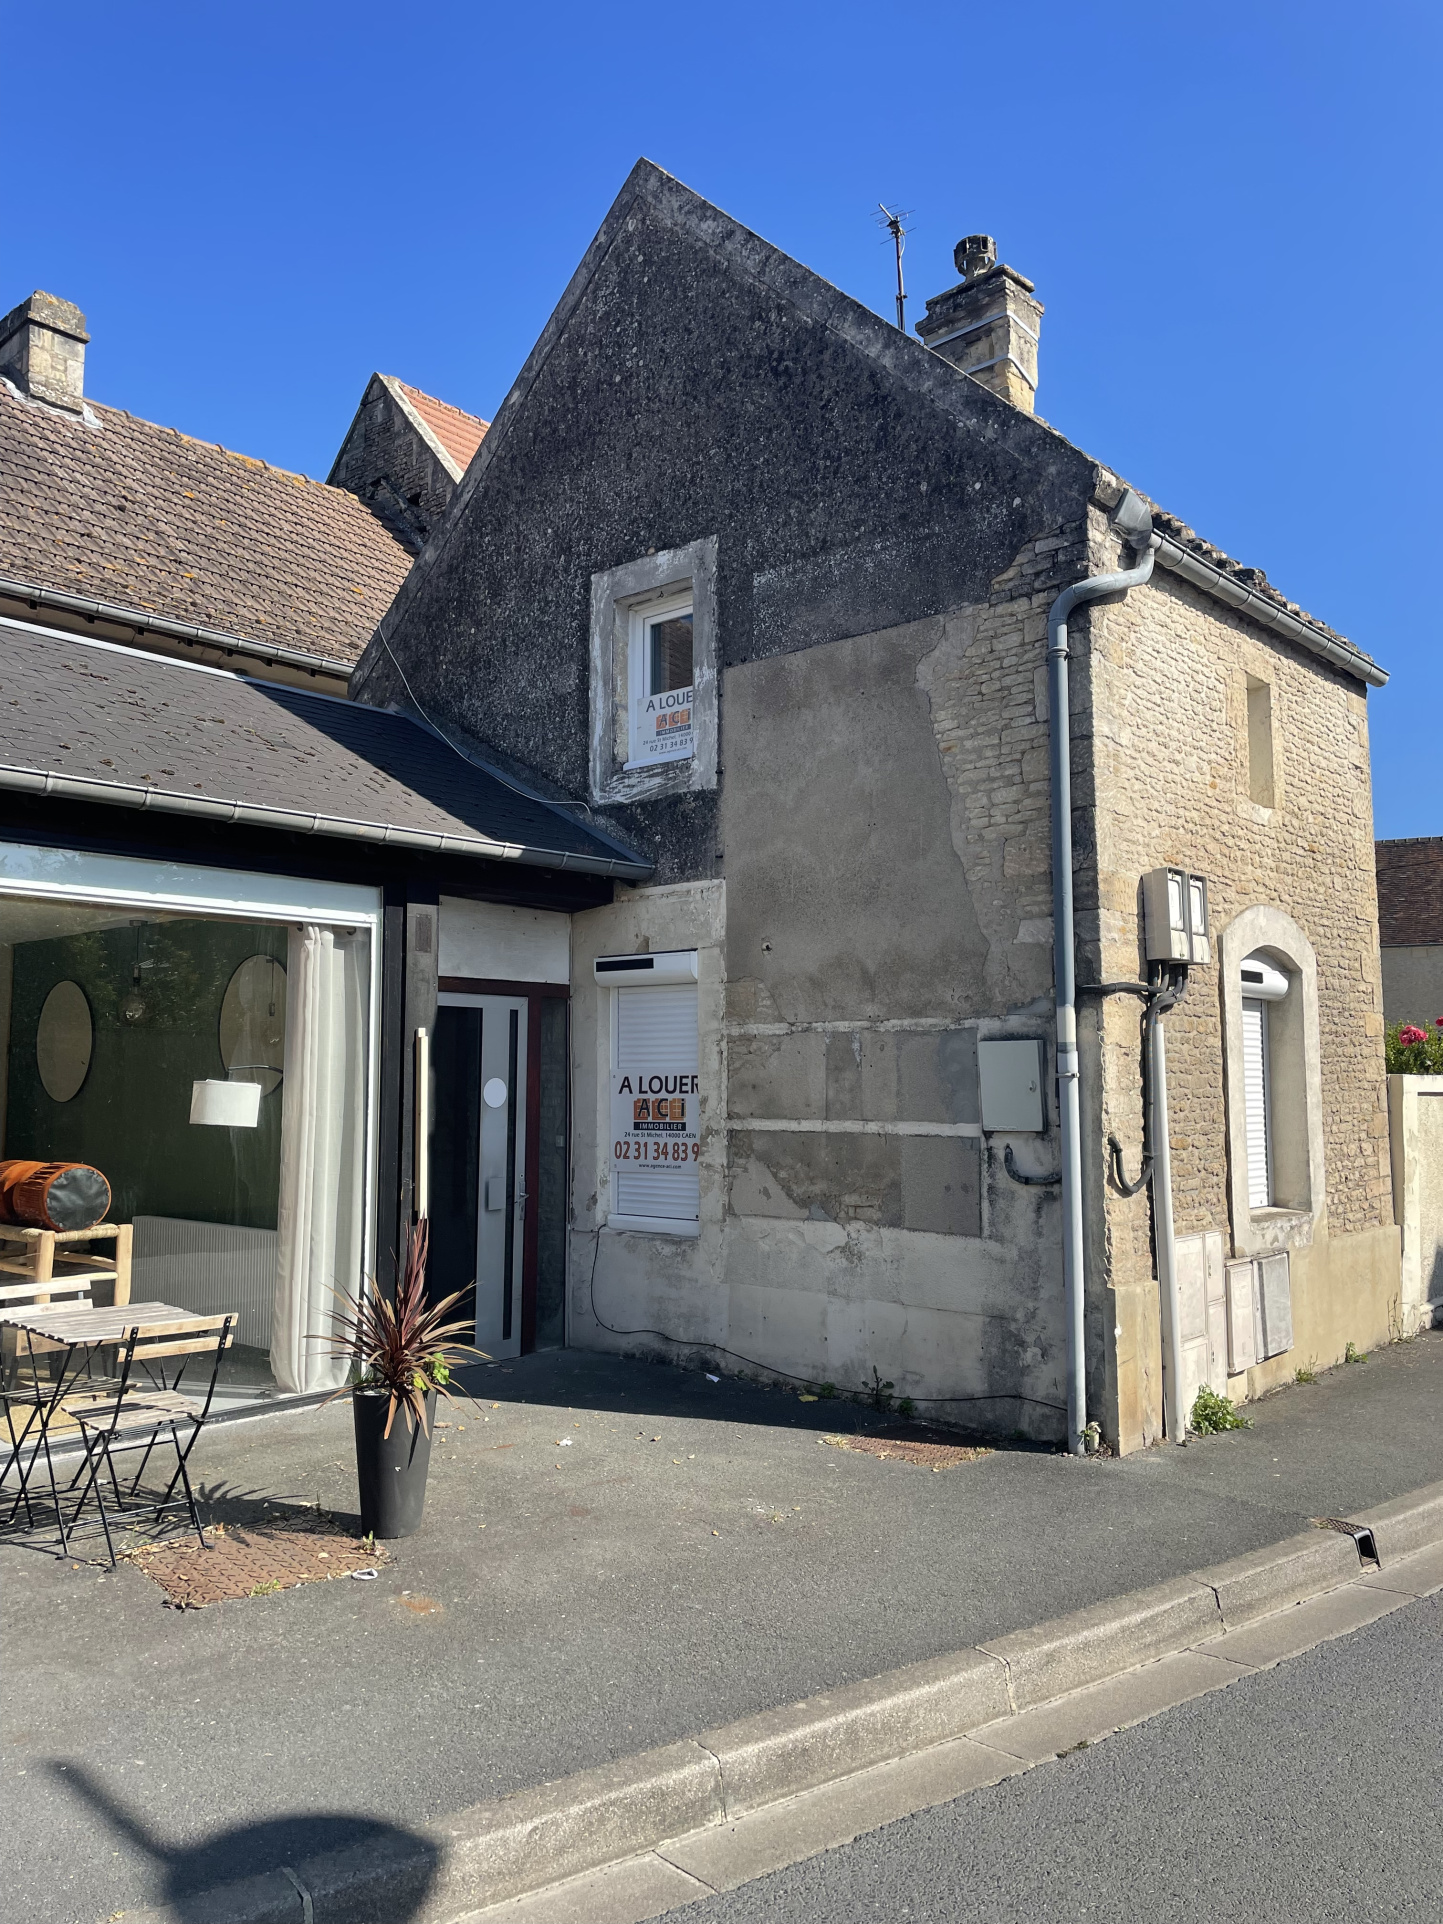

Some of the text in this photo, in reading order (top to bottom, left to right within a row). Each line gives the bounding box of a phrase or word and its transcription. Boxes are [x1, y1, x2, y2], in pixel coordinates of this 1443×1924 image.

[646, 700, 656, 713] A
[618, 1075, 699, 1094] A LOUER
[614, 1141, 630, 1160] 02
[634, 1141, 648, 1160] 31
[653, 1142, 669, 1160] 34
[672, 1142, 688, 1162] 83
